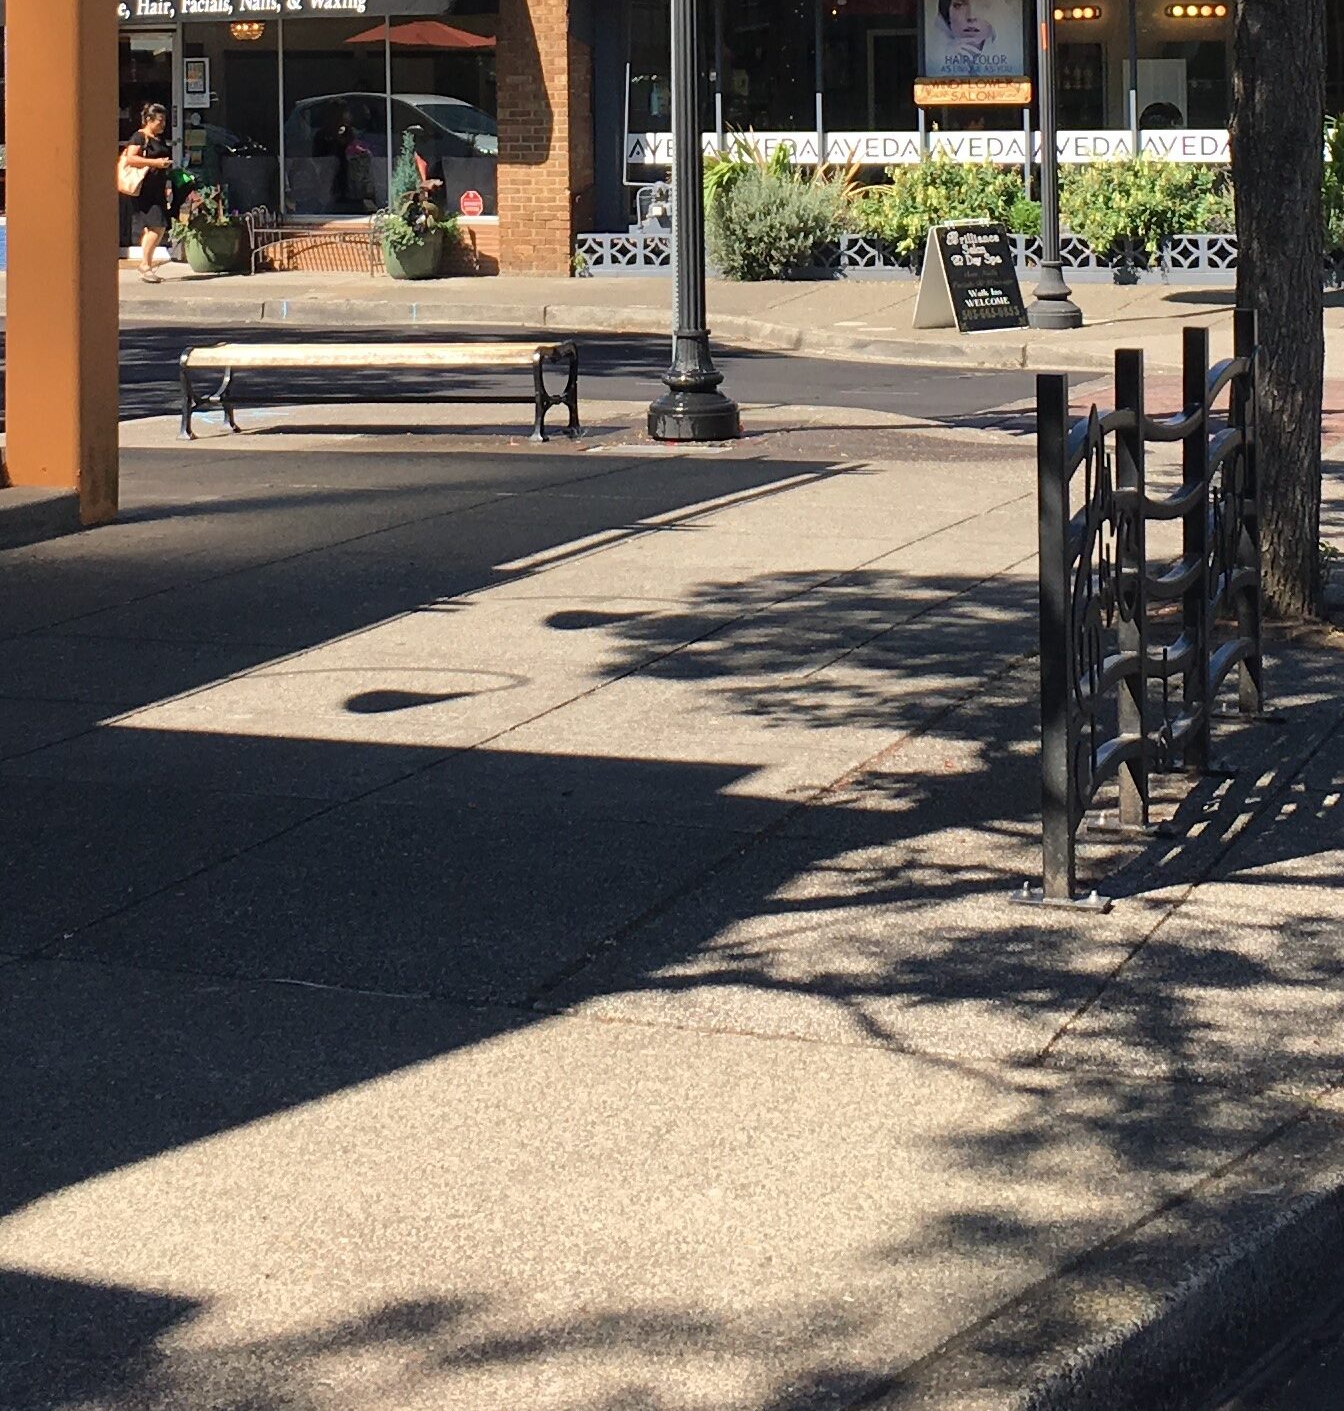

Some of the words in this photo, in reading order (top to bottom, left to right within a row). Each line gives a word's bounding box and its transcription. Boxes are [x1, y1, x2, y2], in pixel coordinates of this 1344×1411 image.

[951, 91, 996, 101] SALON
[727, 138, 817, 159] AEDA
[826, 138, 919, 157] AVEDA
[946, 230, 1000, 245] Brilliance
[964, 297, 1010, 307] WELCOME
